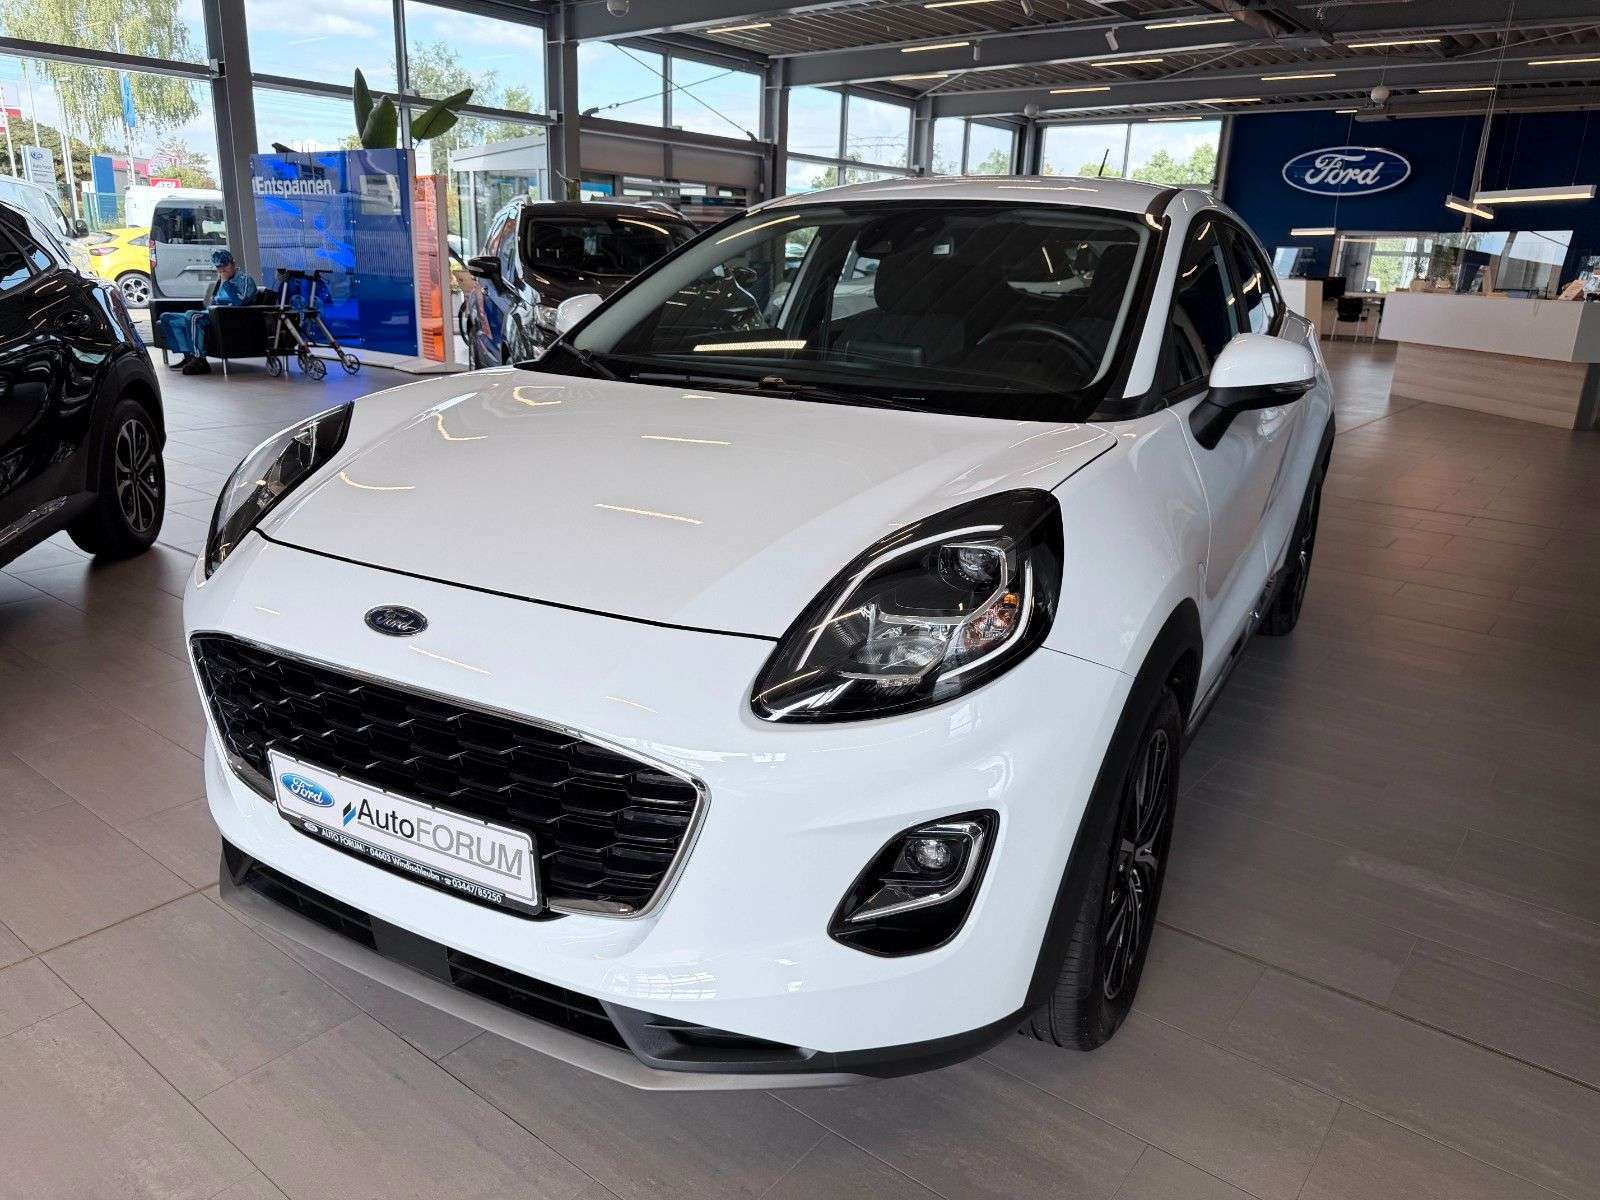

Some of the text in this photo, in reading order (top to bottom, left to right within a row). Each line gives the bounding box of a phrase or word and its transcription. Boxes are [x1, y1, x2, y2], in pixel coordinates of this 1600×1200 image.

[1304, 153, 1385, 185] Ford
[291, 777, 324, 803] Ford
[321, 828, 339, 841] AUTO
[357, 798, 523, 875] AutoFORUM
